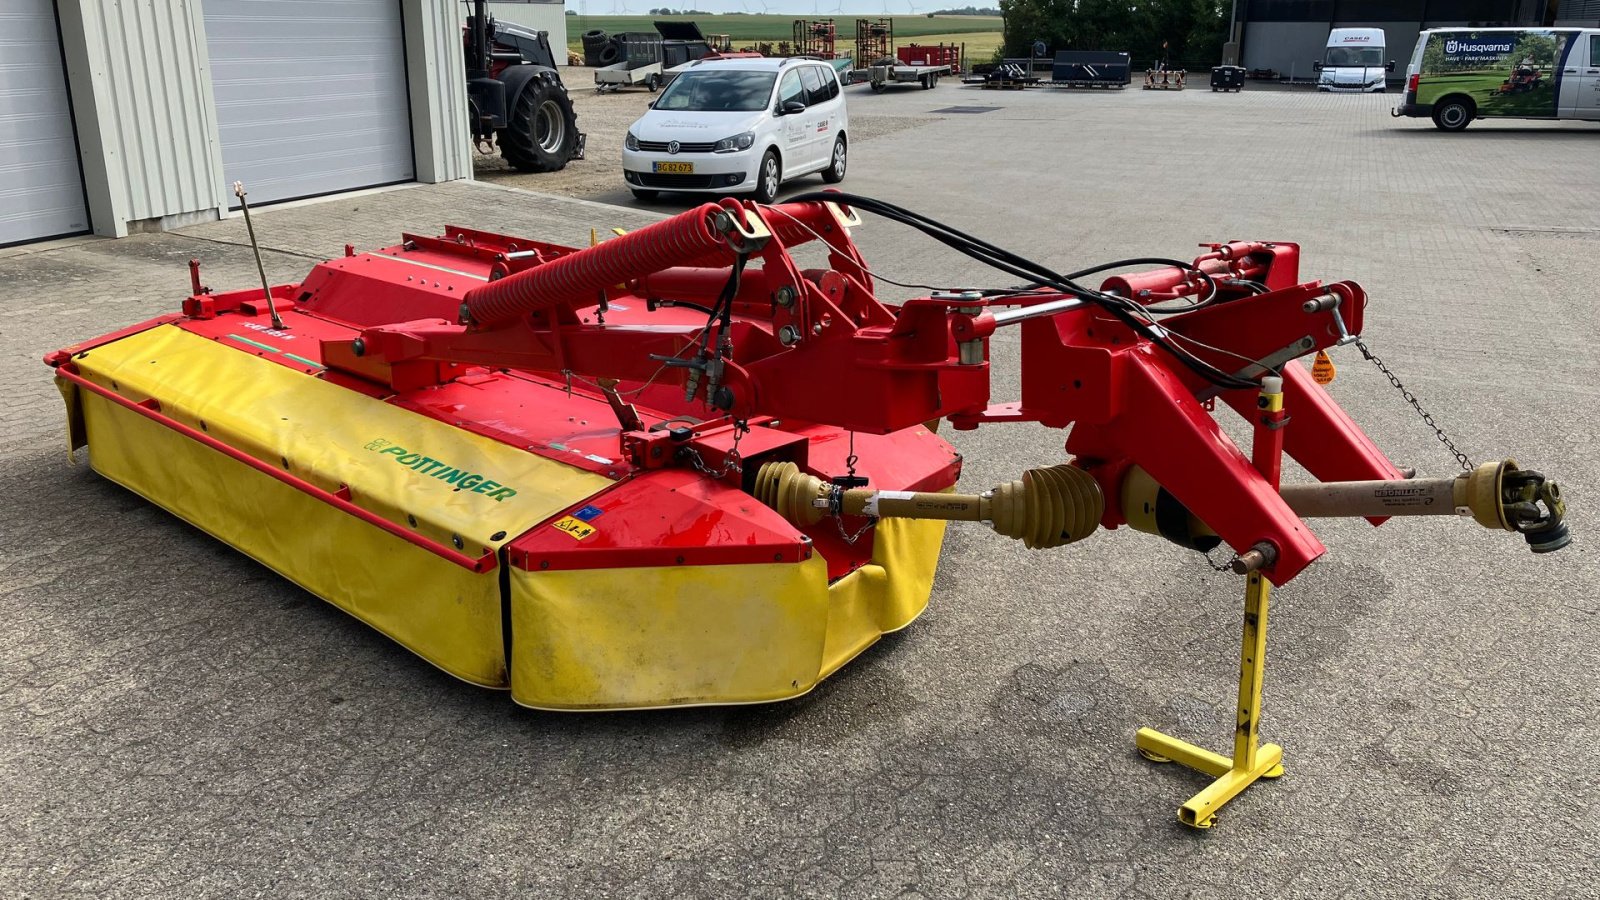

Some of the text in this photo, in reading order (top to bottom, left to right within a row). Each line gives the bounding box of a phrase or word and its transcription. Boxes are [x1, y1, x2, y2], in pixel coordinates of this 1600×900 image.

[1458, 43, 1510, 53] Husqvarna
[657, 163, 692, 172] BG 82 673
